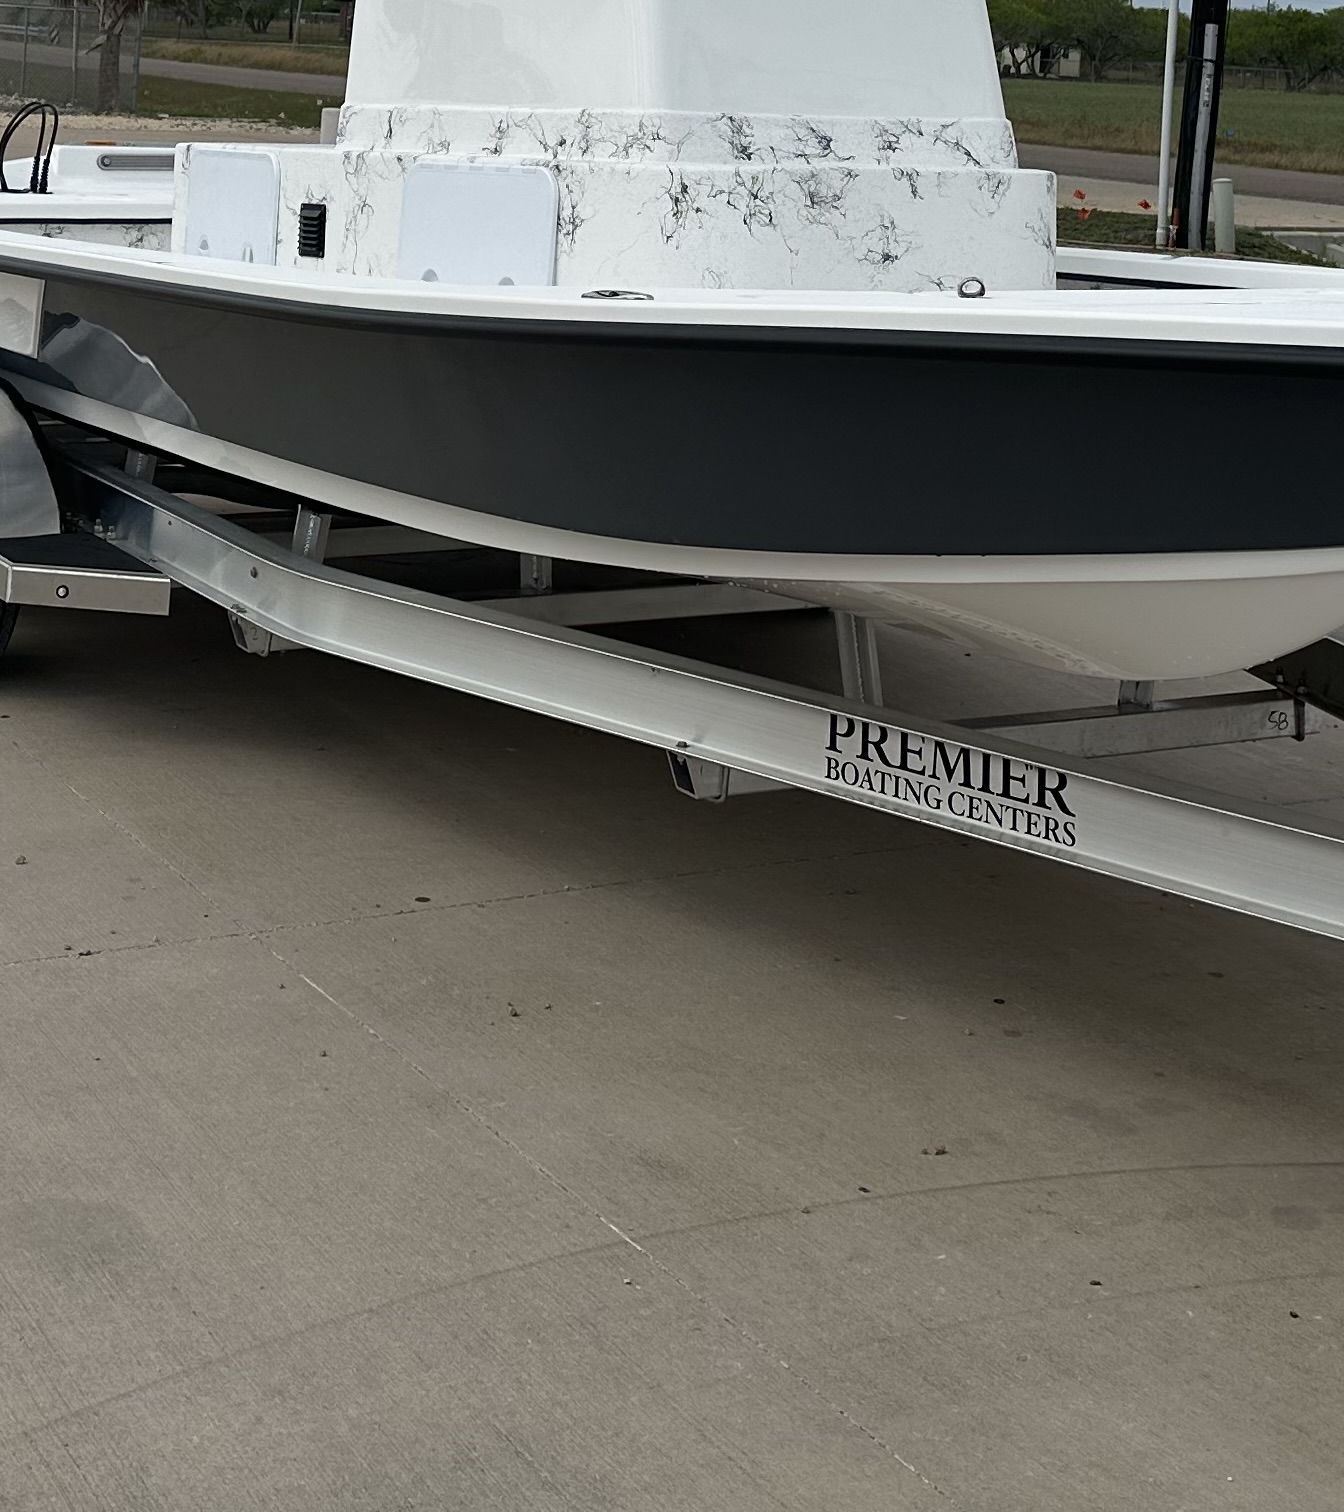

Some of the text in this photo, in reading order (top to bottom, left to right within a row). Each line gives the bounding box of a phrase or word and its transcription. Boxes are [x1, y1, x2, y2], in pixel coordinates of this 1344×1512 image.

[825, 713, 1077, 818] PREMIER
[1267, 710, 1289, 731] 58
[824, 755, 1077, 848] BOATING CENTERS
